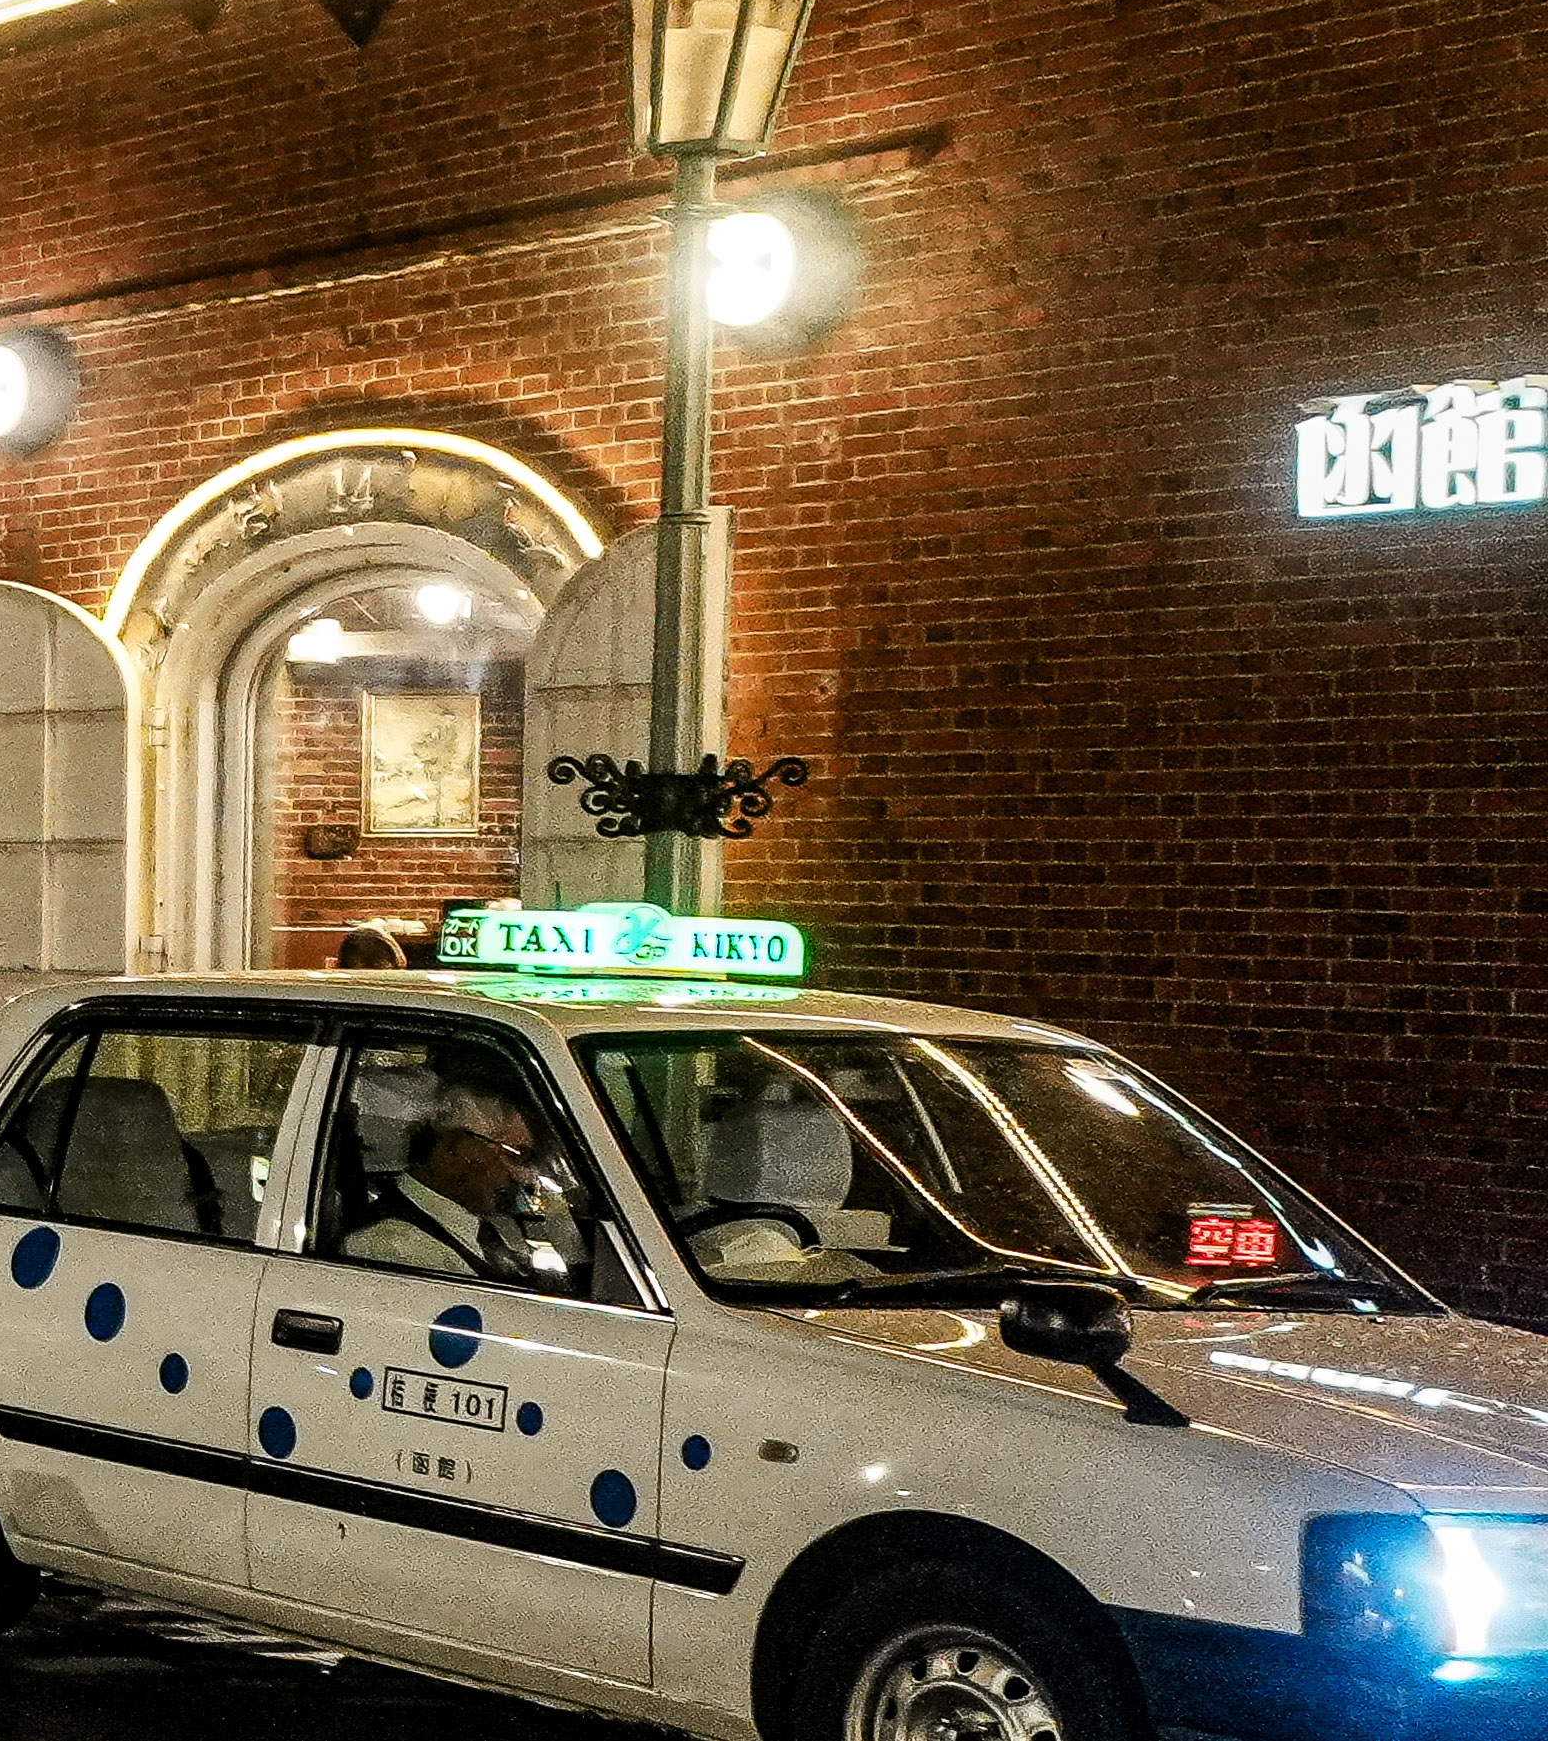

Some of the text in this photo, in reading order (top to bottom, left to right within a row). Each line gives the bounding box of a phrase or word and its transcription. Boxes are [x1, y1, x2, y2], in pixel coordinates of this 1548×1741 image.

[445, 936, 477, 956] OK
[498, 922, 785, 963] TAXI KIKYO
[1188, 1217, 1276, 1266] 空車
[451, 1389, 495, 1420] 101
